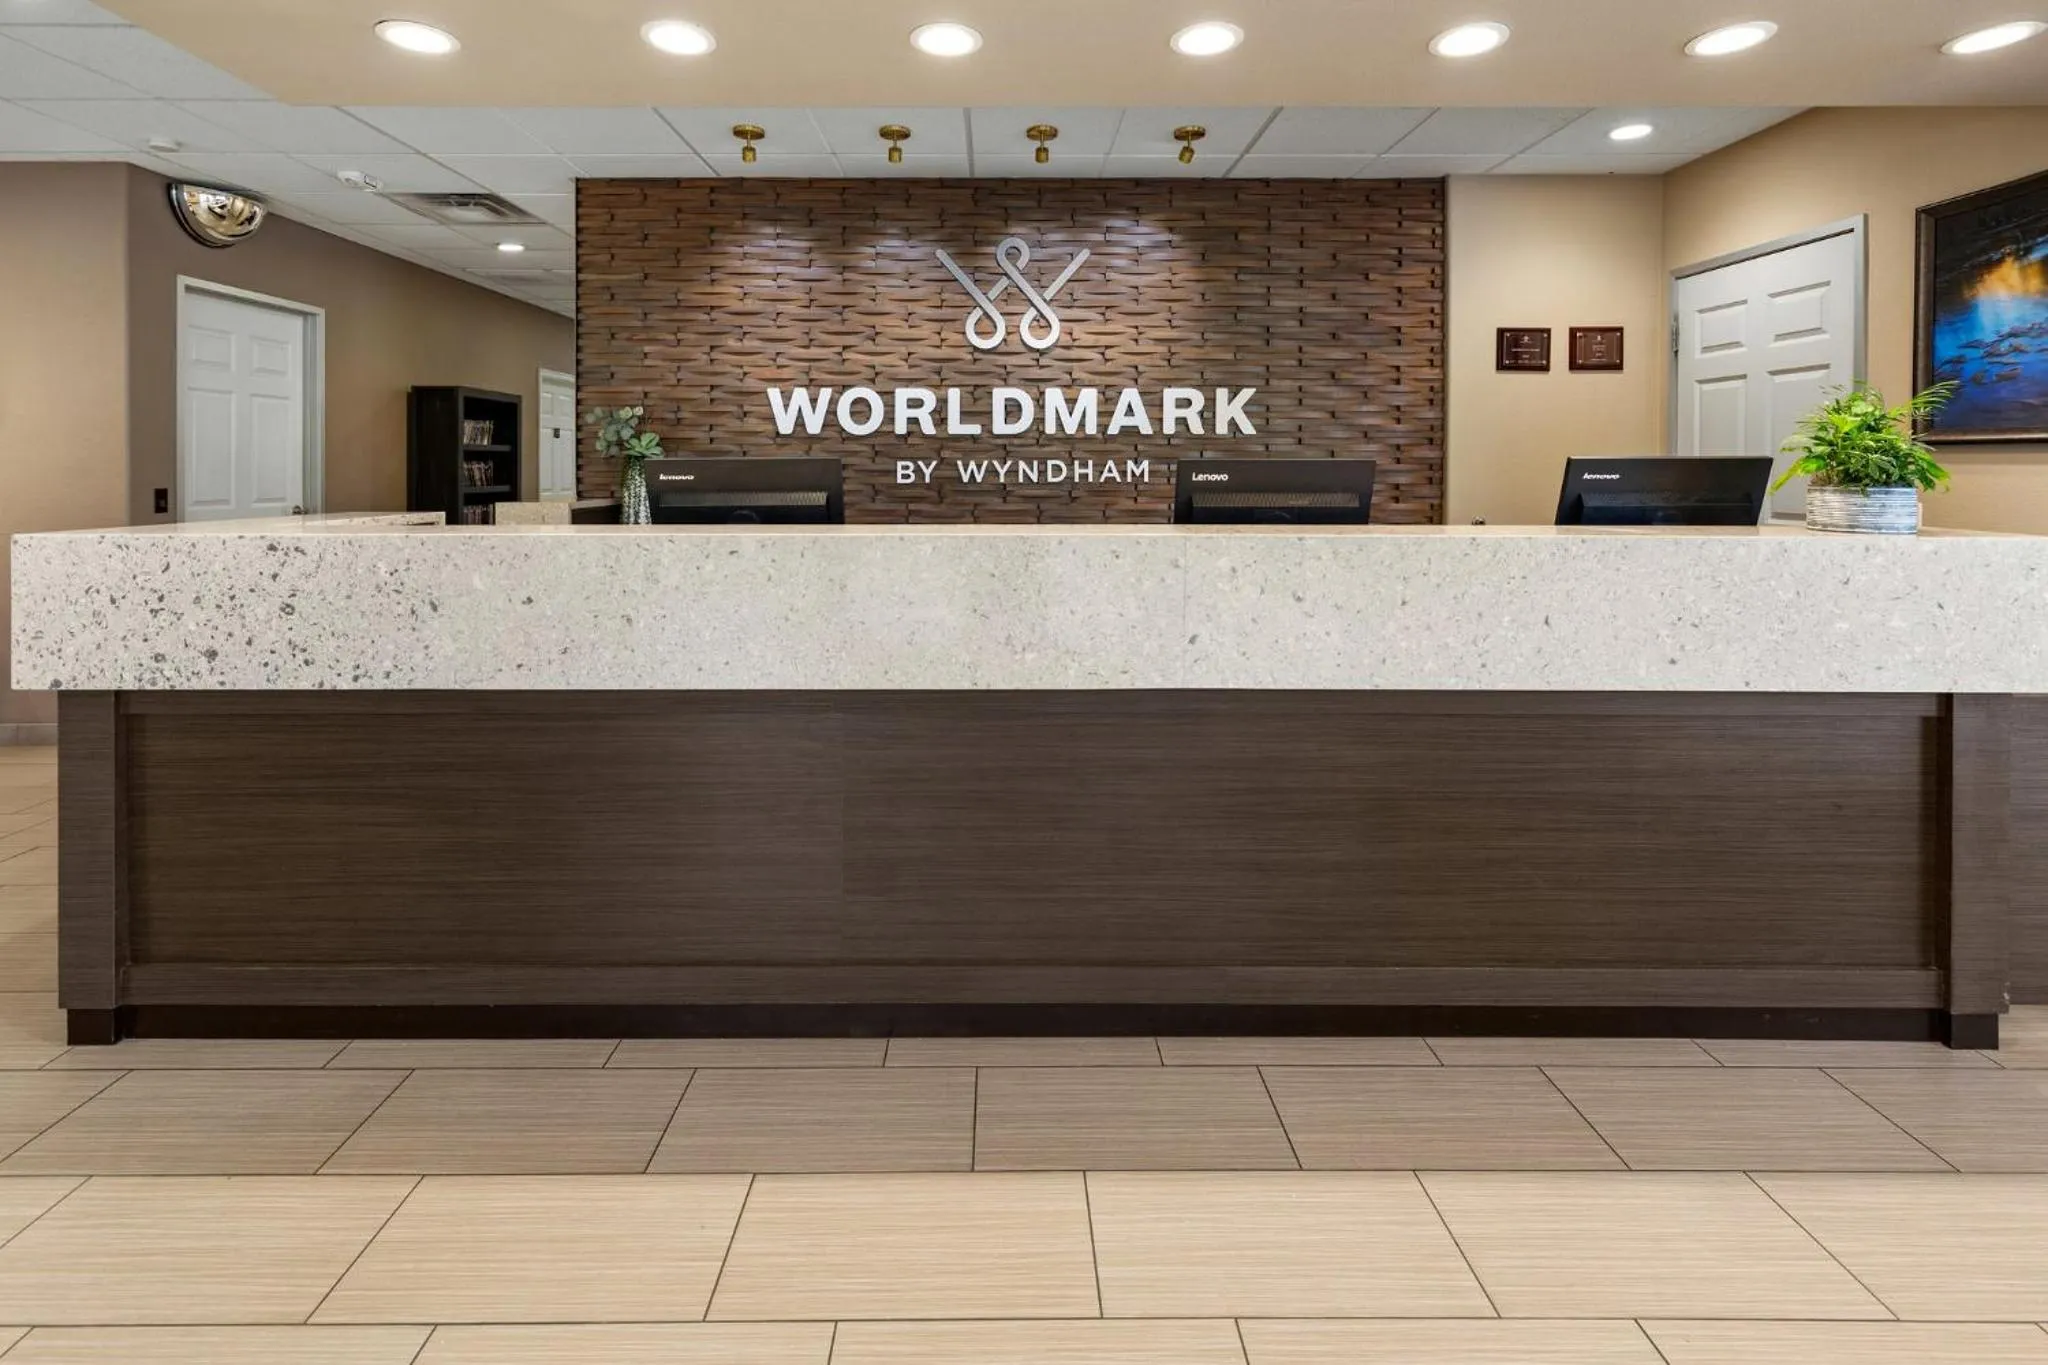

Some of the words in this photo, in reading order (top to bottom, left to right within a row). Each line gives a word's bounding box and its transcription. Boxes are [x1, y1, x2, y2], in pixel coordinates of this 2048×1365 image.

[766, 386, 1257, 435] WORLDMARK
[895, 460, 937, 484] BY
[957, 459, 1151, 484] WYNDHAM
[1191, 472, 1229, 482] Lenovo
[1583, 472, 1620, 480] lenovo
